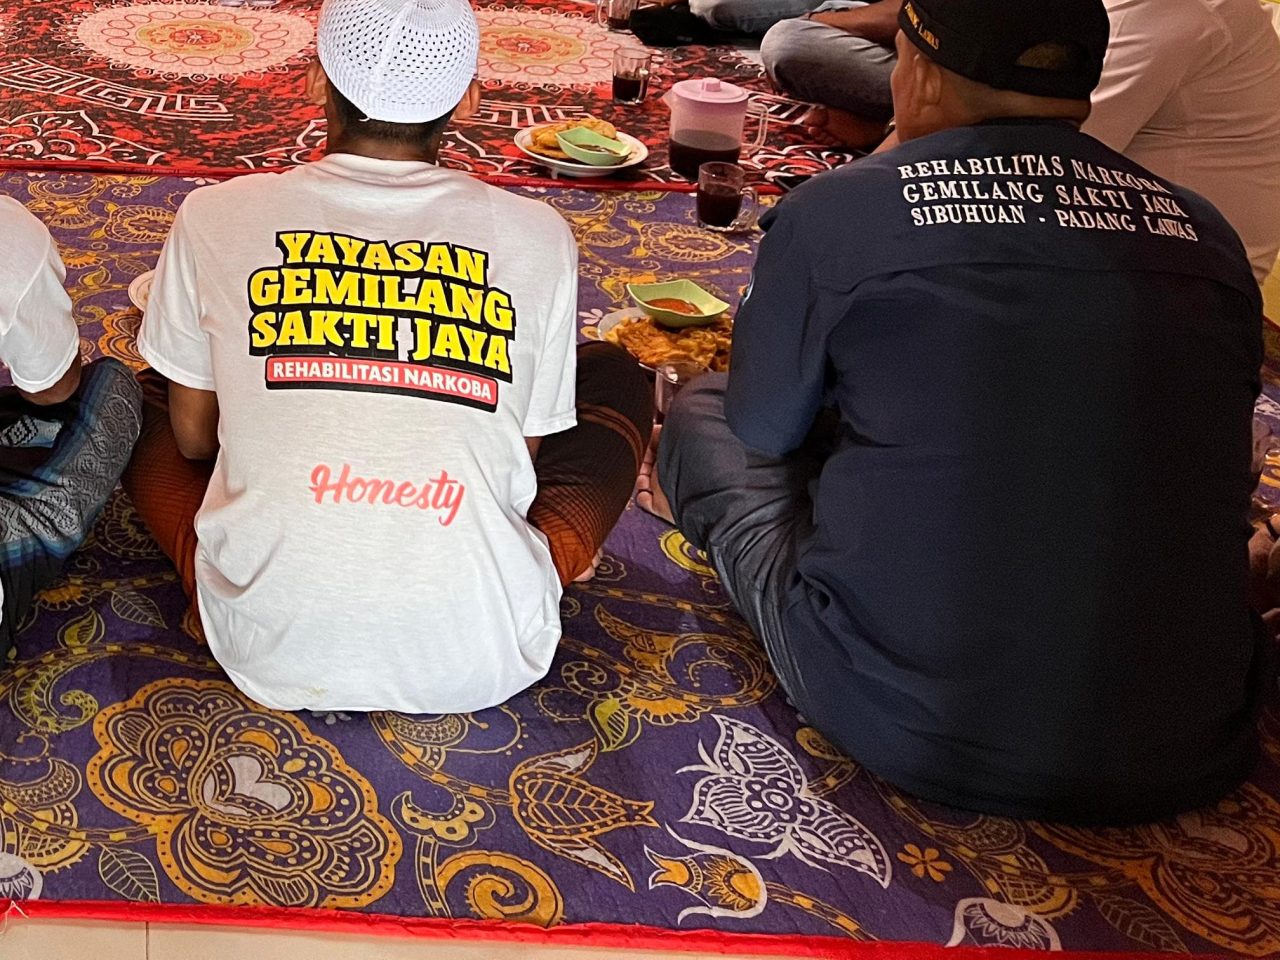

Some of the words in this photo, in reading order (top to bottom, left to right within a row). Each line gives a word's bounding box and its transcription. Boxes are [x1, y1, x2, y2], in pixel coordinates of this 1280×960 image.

[898, 154, 1065, 179] REHABILITAS
[1071, 158, 1174, 195] NARKOBA
[902, 180, 1044, 204] GEMILANG
[1055, 185, 1134, 210] SAKTI
[1143, 194, 1190, 218] JAYA
[910, 204, 1026, 226] SIBUHUAN
[1054, 209, 1136, 233] PADANG
[1144, 218, 1199, 242] LAWAS
[279, 232, 486, 286] YAYASAN
[249, 268, 514, 331] GEMILANG
[251, 310, 396, 351] SAKTI
[411, 318, 511, 374] JAYA
[272, 362, 400, 383] REHABILITASI
[404, 368, 492, 400] NARKOBA
[308, 463, 465, 527] Honesty
